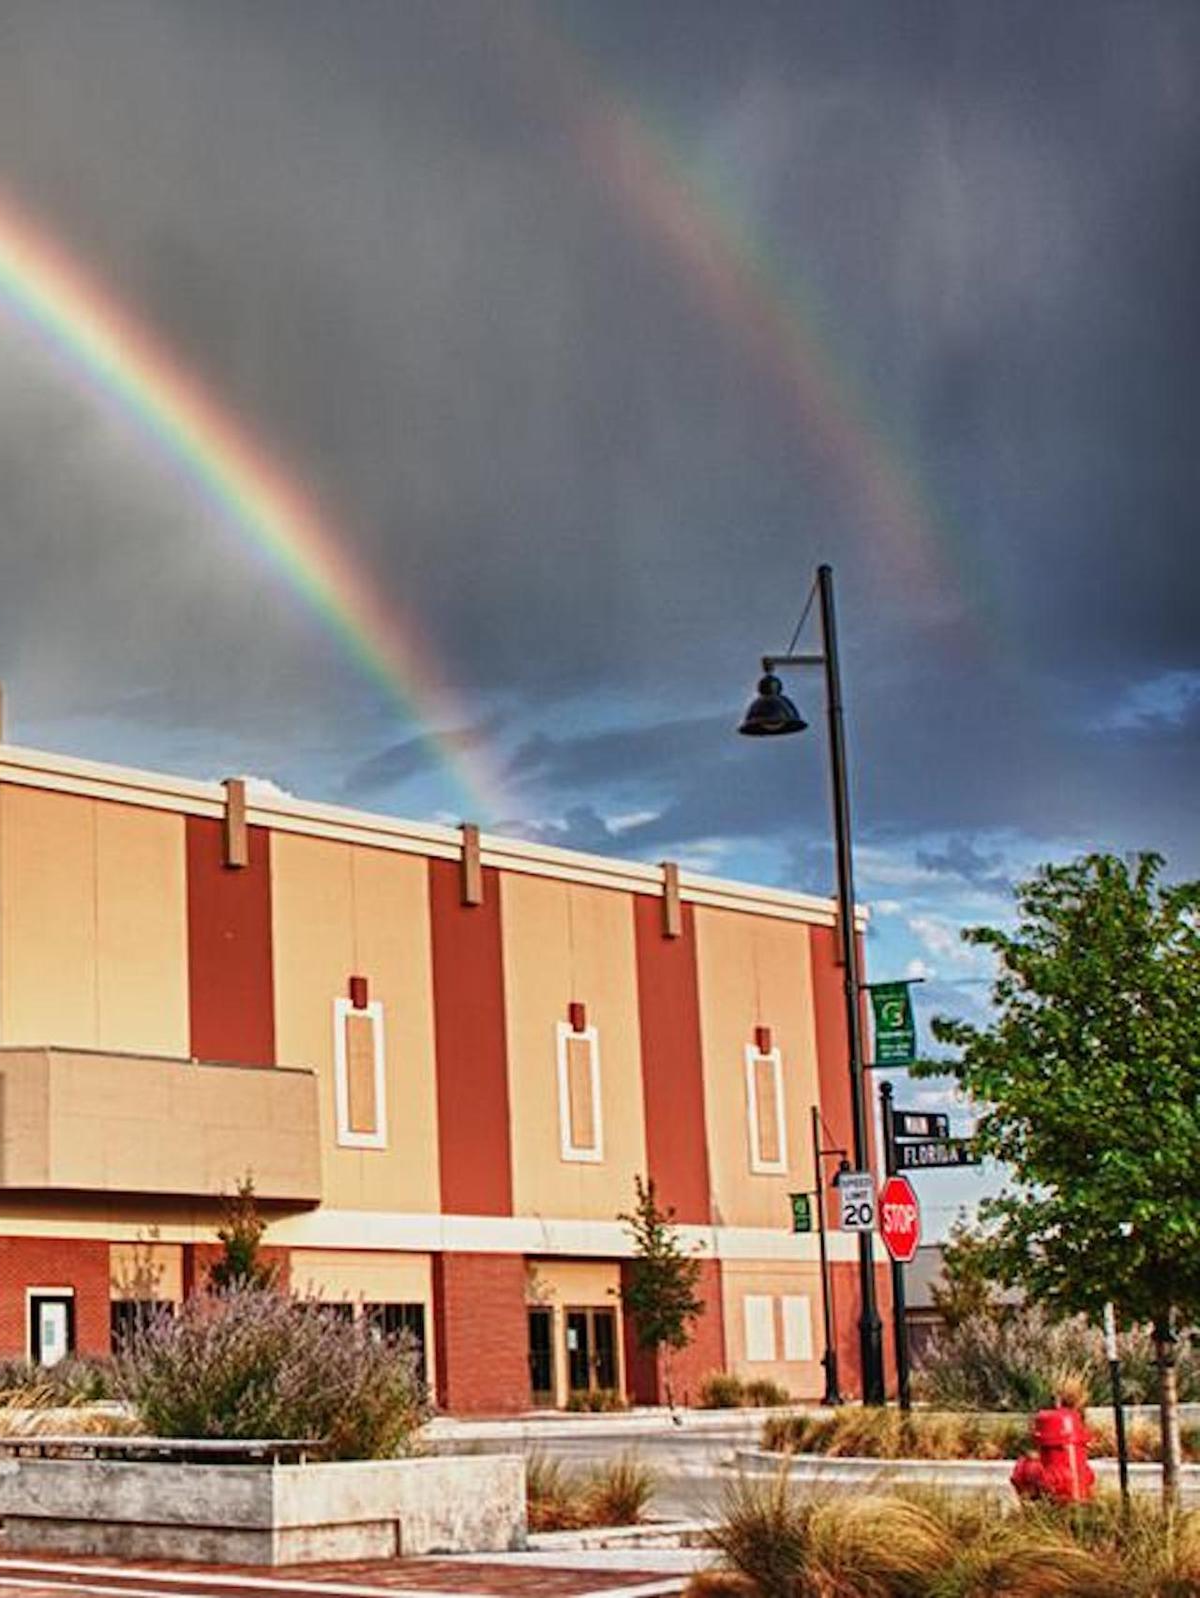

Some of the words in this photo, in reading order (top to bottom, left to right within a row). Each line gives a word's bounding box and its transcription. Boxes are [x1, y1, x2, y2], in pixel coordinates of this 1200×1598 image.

[903, 1144, 959, 1166] FLORIDA
[844, 1203, 873, 1226] 20
[883, 1204, 917, 1234] STOP
